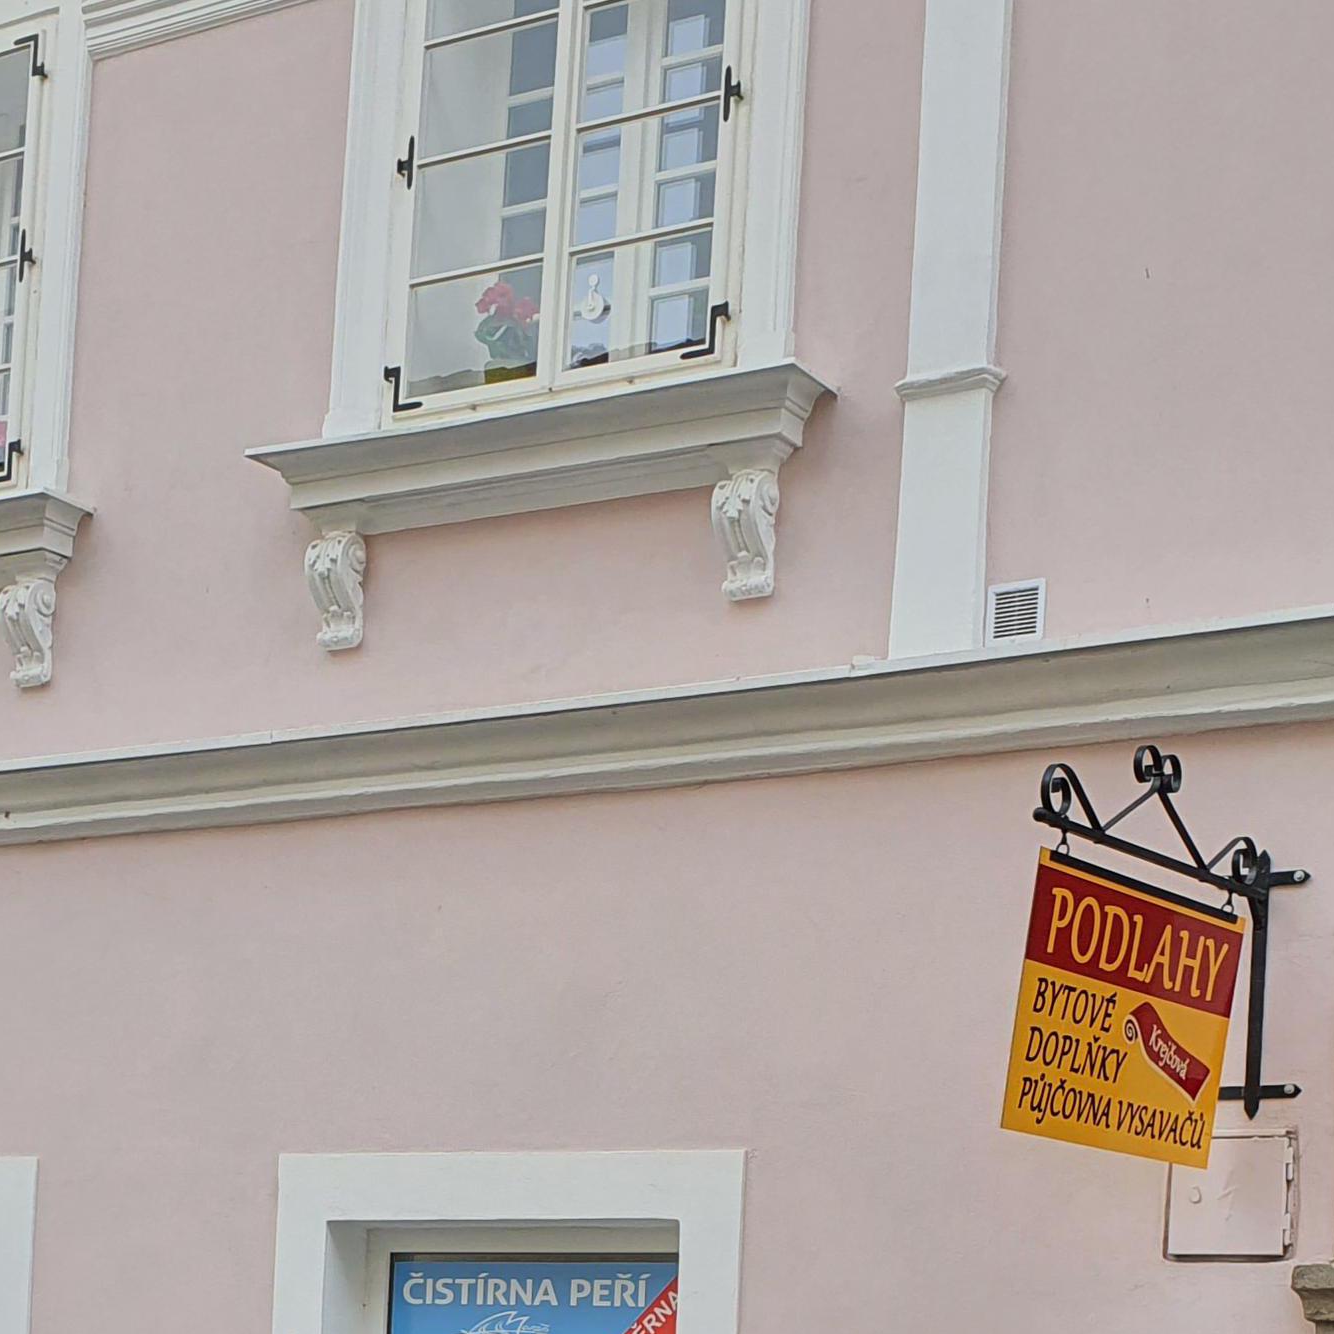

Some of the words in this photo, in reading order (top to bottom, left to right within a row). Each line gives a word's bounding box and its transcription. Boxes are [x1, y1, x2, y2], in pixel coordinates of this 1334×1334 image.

[1046, 888, 1229, 1001] PODLAHY
[1032, 977, 1117, 1034] BYTOVÉ
[1025, 1025, 1128, 1084] DOPLŇKY
[1148, 1023, 1190, 1080] Krejčová
[1017, 1072, 1111, 1129] PŮJČOVNA
[1117, 1099, 1207, 1150] VYSAVAČŮ
[402, 1272, 558, 1306] ČISTÍRNA
[570, 1273, 652, 1307] PEŘÍ
